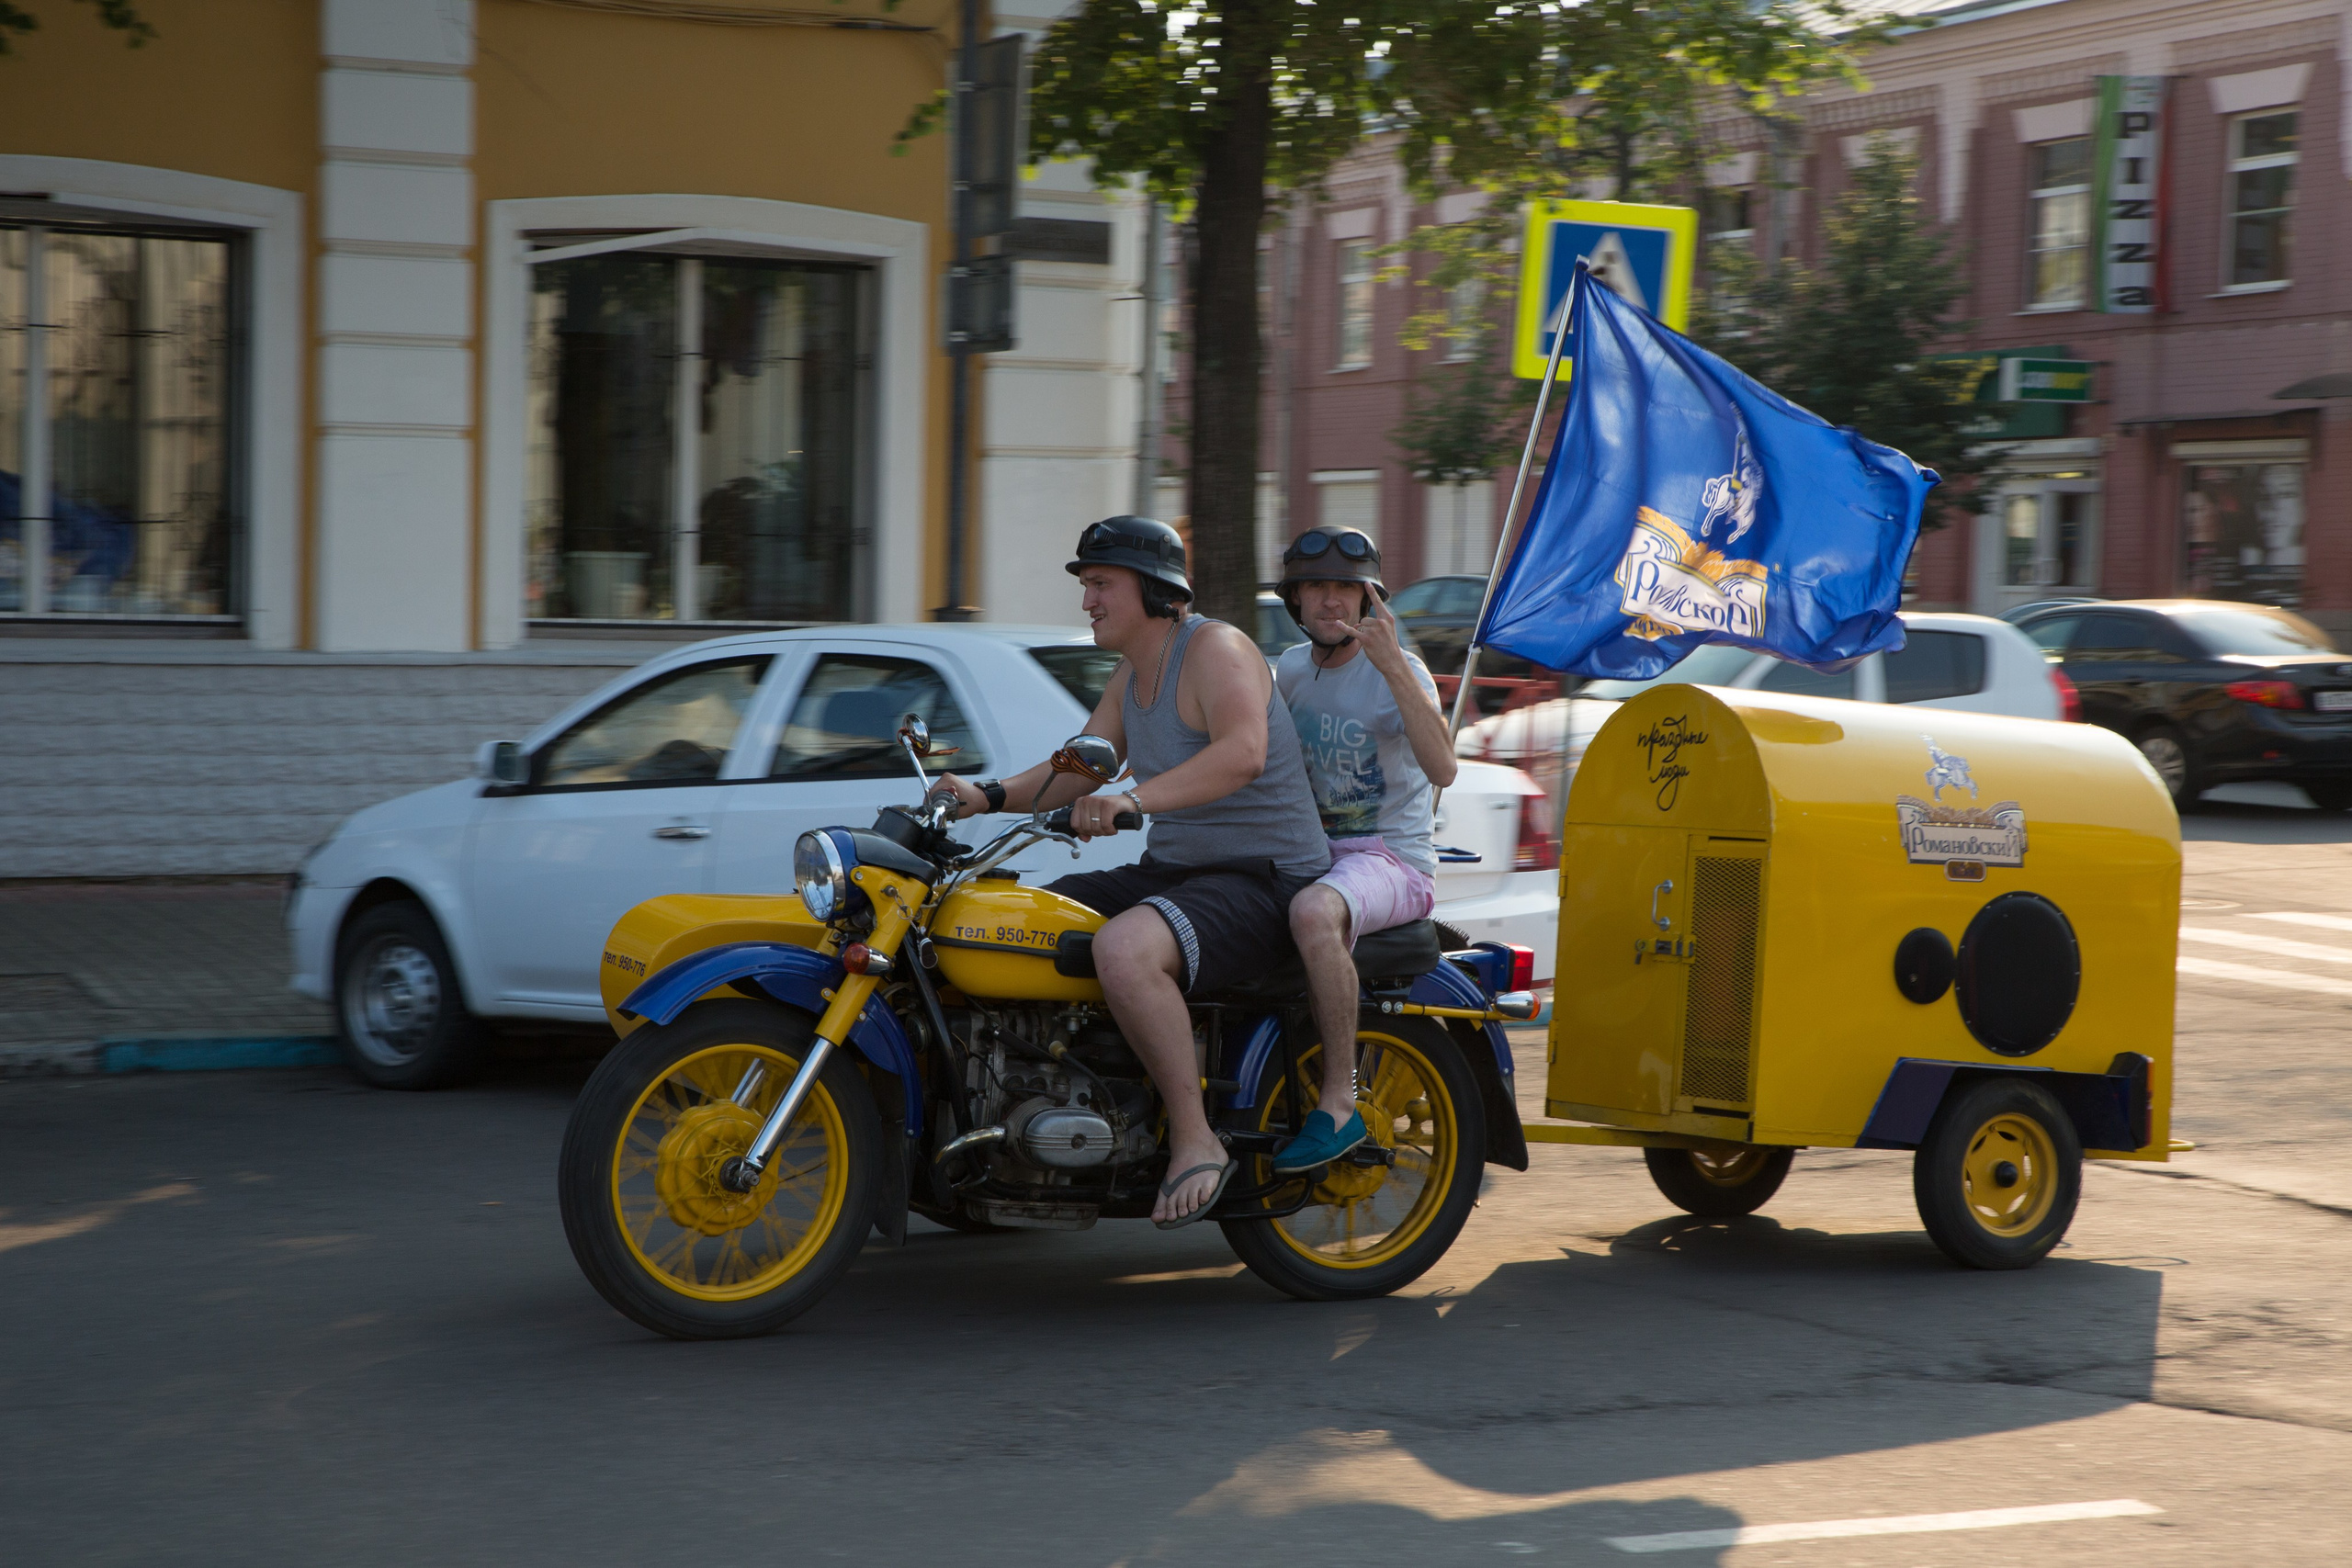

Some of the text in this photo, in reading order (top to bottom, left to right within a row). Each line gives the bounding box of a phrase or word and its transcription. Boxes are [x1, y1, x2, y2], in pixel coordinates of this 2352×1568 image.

[1319, 712, 1367, 749] BIG
[1303, 740, 1373, 776] AVEL
[956, 926, 1056, 947] тел. 950-776
[604, 951, 646, 977] тел. 950-776
